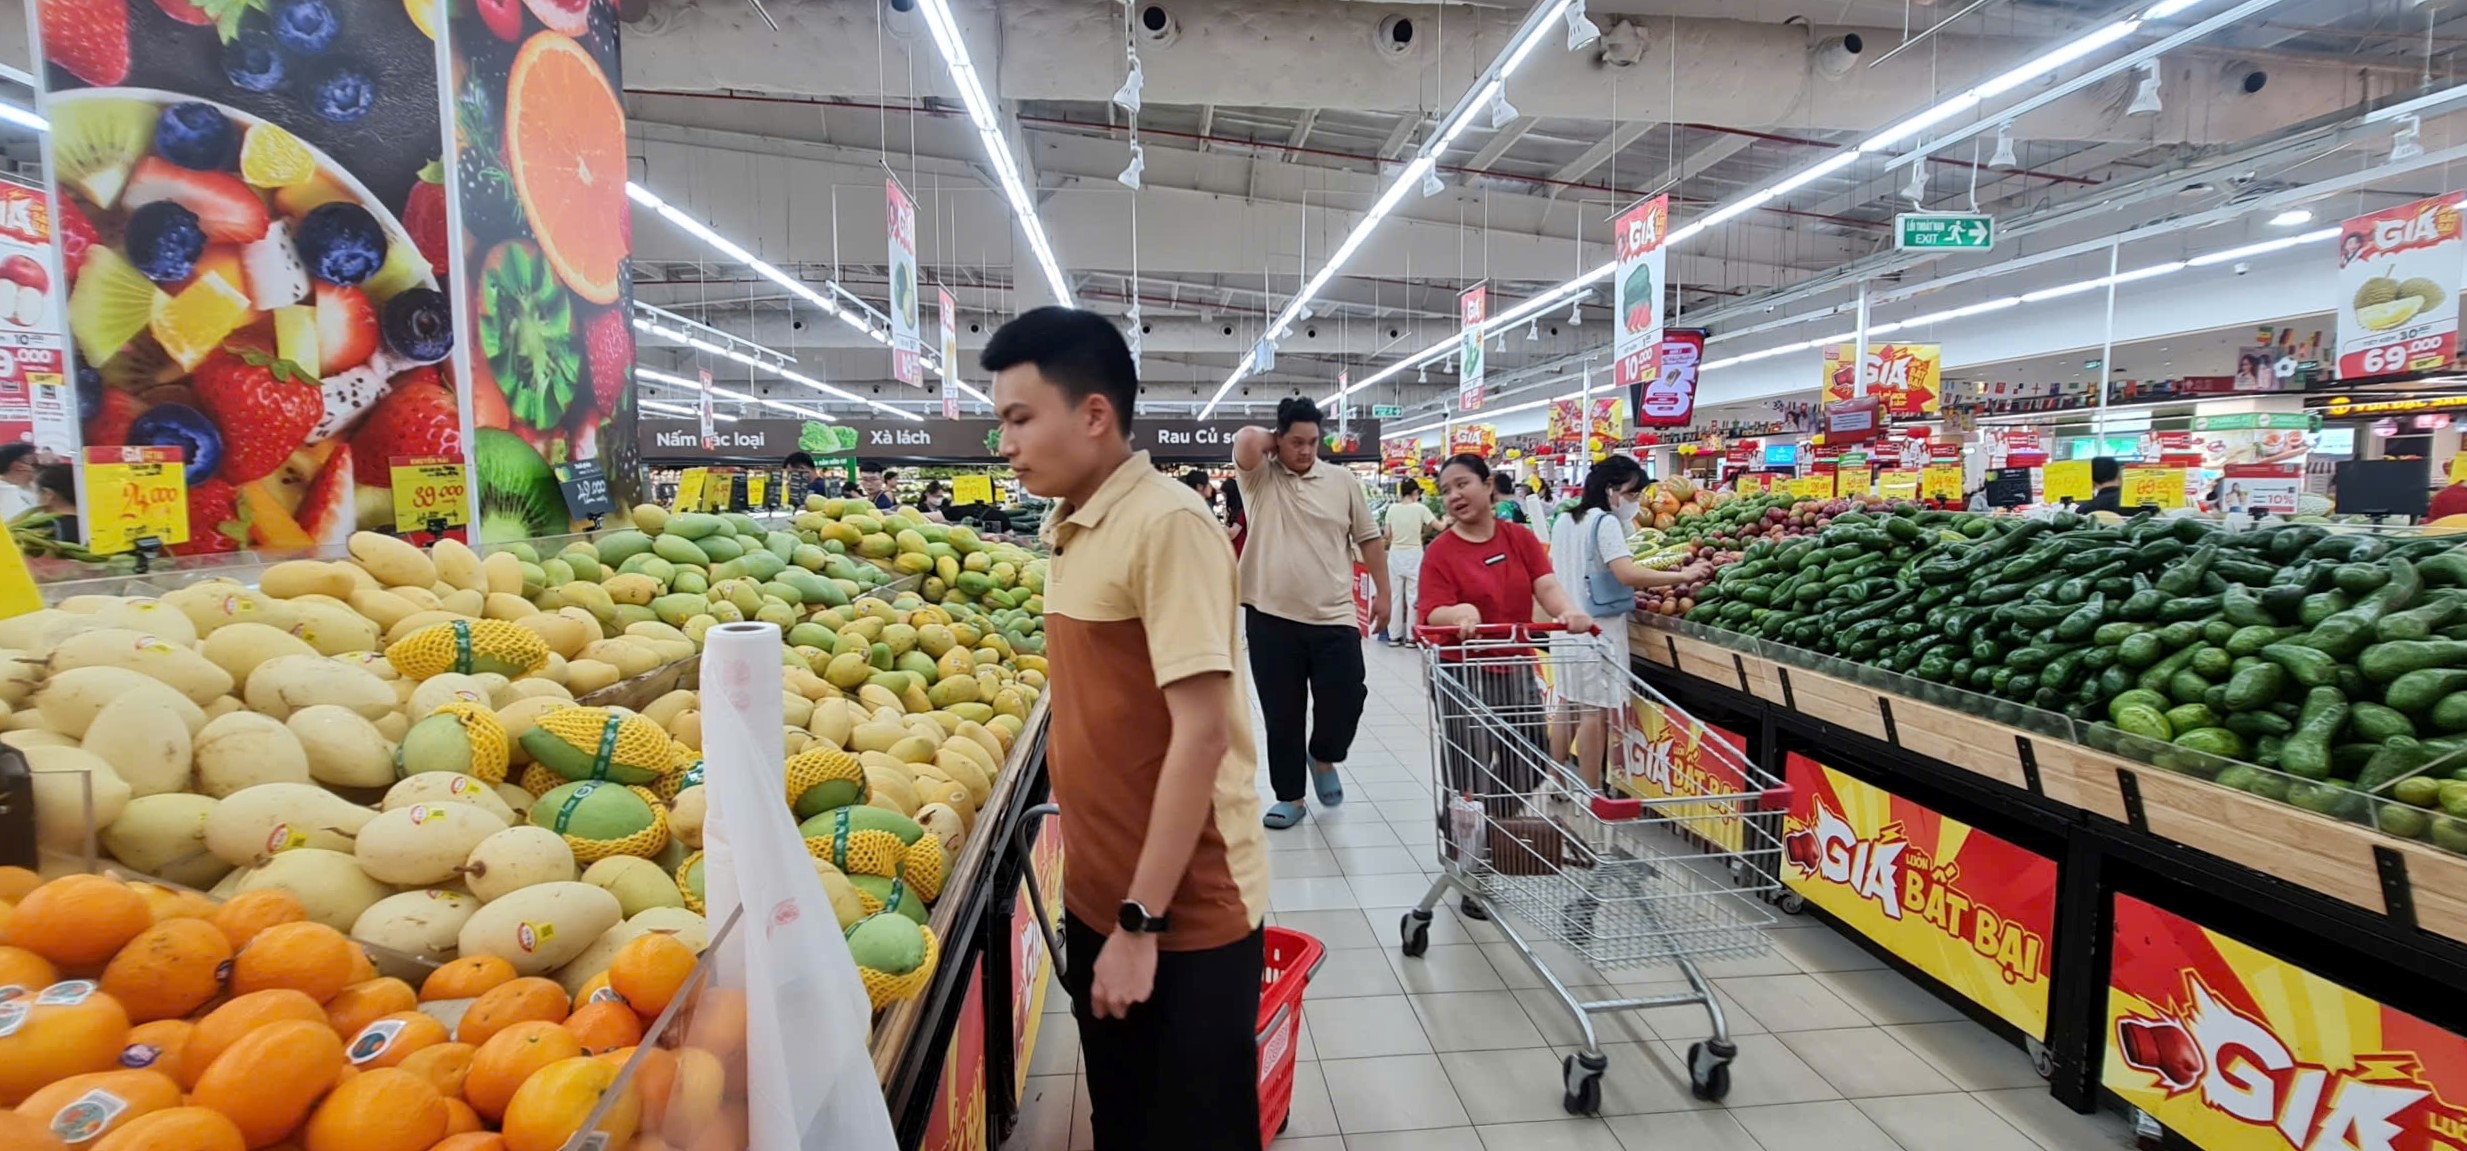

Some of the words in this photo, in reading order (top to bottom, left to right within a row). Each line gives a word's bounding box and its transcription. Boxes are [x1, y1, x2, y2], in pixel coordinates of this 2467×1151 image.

[1629, 205, 1657, 251] GIÁ
[1915, 233, 1938, 244] EXIT
[2374, 203, 2441, 249] GIÁ
[656, 430, 697, 446] Nấm
[734, 431, 765, 449] loại
[871, 429, 893, 445] Xà
[897, 429, 931, 445] lách
[1158, 430, 1190, 444] Rau
[1195, 427, 1218, 444] Củ
[1624, 724, 1674, 795] GIÁ
[1673, 748, 1706, 795] BẤT
[1818, 803, 1908, 919] GIÁ
[1906, 852, 1929, 870] LUÔN
[1904, 862, 1969, 936] BẤT
[1974, 908, 2041, 984] BẠI
[2188, 975, 2433, 1151] GIÁ
